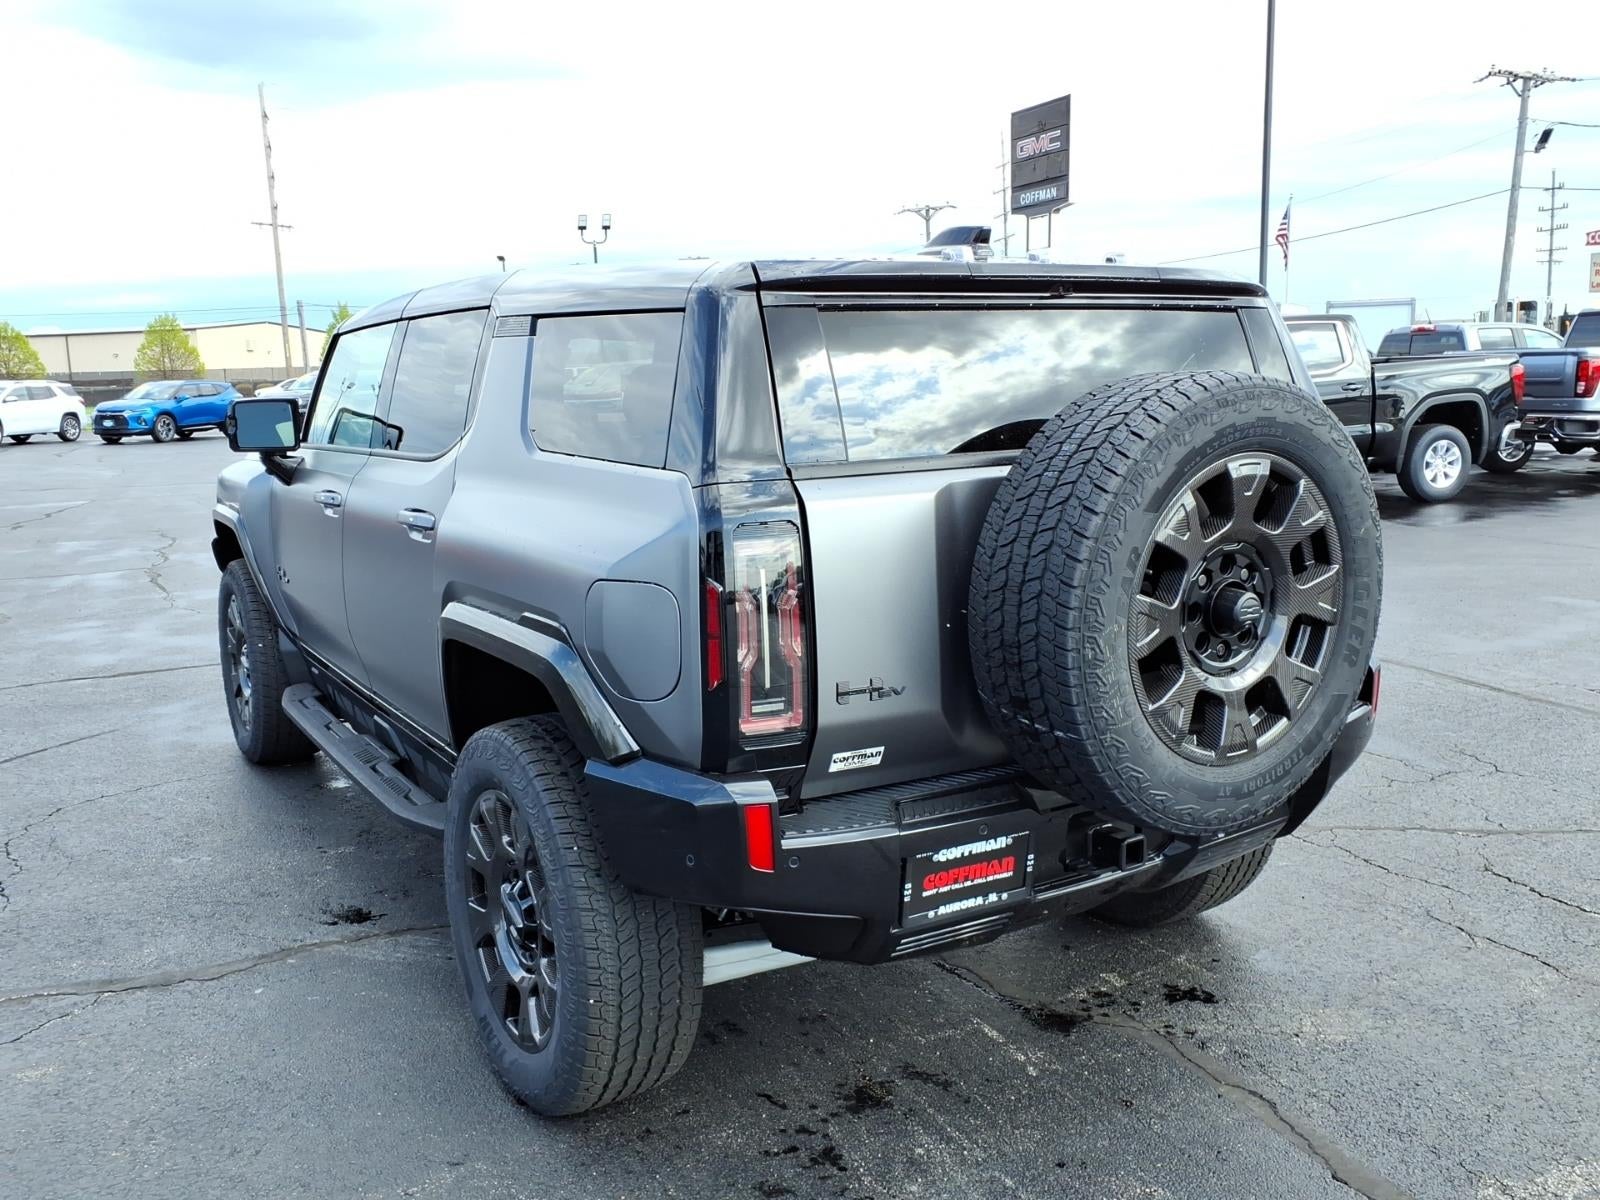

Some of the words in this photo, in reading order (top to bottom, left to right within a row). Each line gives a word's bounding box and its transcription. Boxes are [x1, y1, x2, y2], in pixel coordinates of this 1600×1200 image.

[1016, 129, 1061, 159] GMC
[1020, 186, 1057, 205] COFFMAN
[833, 750, 882, 764] COFFMAN
[1243, 746, 1305, 794] TERRITORY
[938, 836, 1006, 862] COFFMAN
[922, 855, 1016, 891] COFFMAN
[937, 895, 984, 915] AURORA
